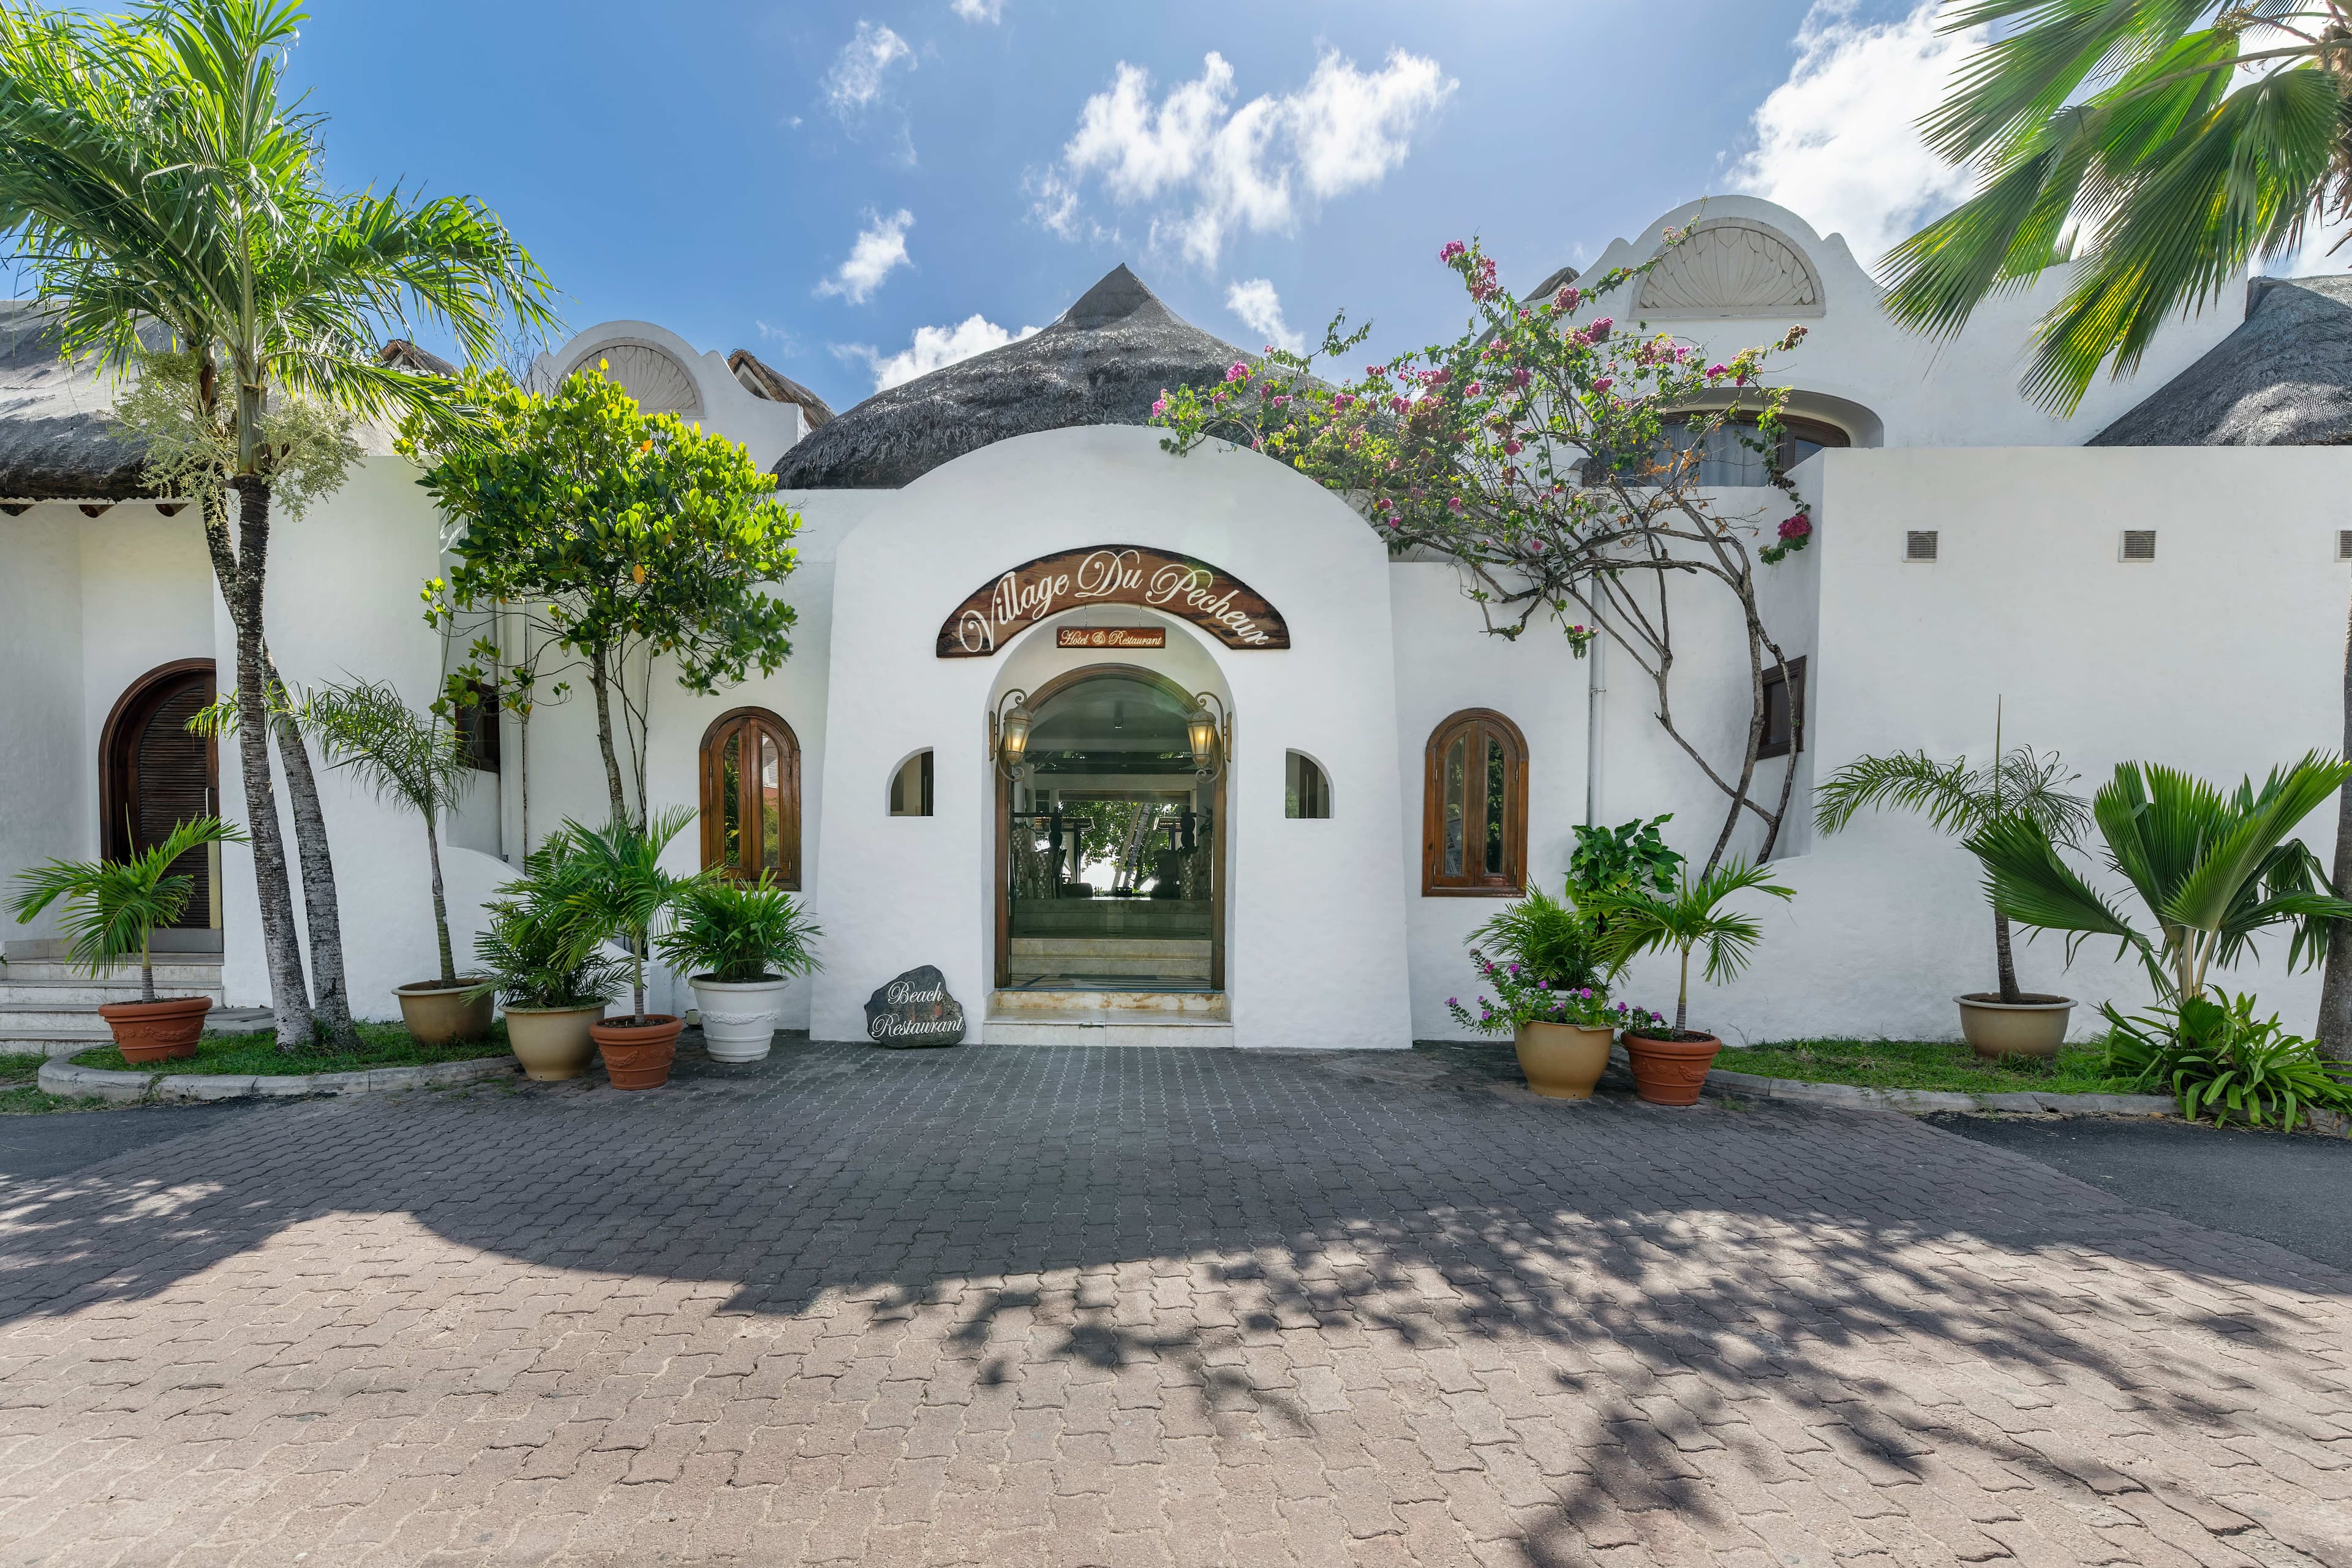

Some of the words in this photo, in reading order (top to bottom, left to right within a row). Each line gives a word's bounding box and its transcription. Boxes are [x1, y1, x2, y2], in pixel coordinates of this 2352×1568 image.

[959, 571, 1069, 652] Village
[1074, 549, 1143, 597] Du
[1145, 564, 1269, 645] Pecheur
[1060, 630, 1089, 646] Hotel
[1092, 631, 1106, 645] &
[1109, 630, 1162, 646] Restaurant
[888, 981, 944, 1005] Beach
[871, 1014, 964, 1038] Restaurant
